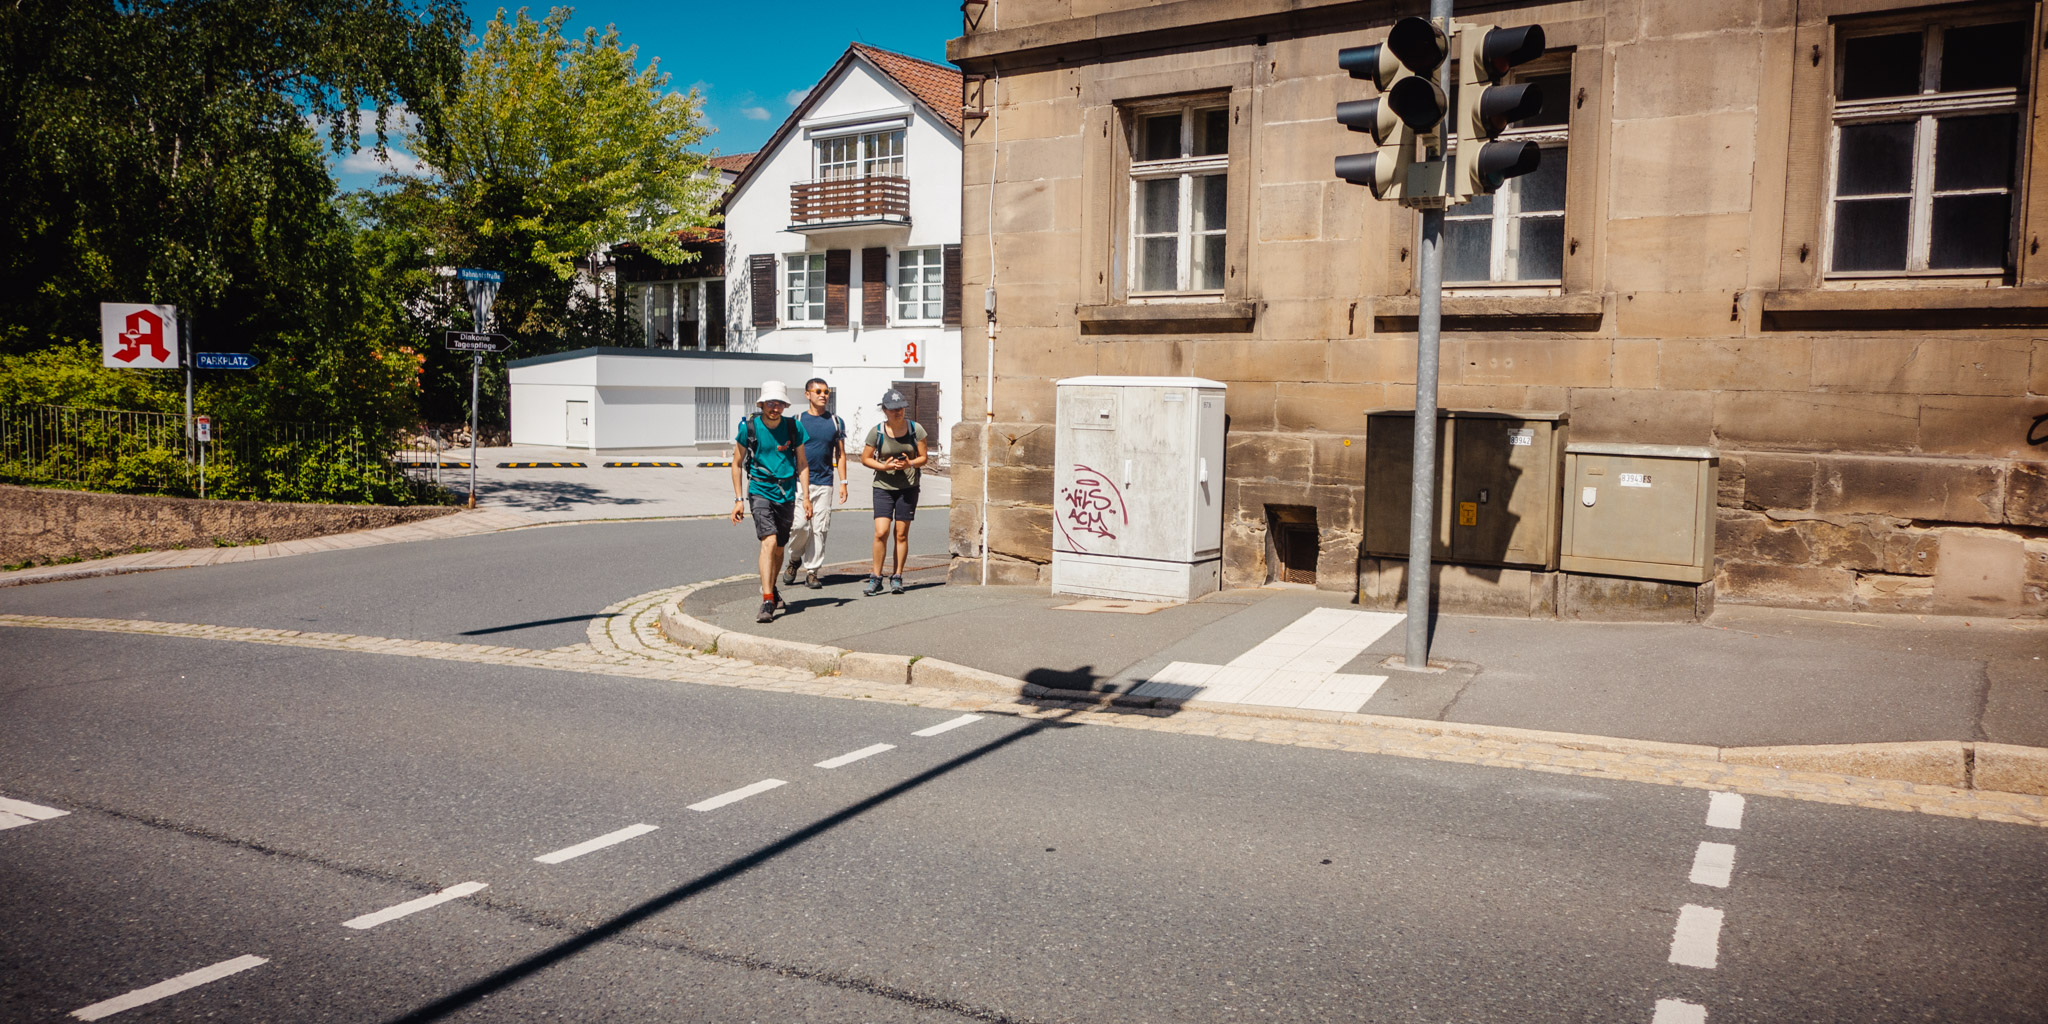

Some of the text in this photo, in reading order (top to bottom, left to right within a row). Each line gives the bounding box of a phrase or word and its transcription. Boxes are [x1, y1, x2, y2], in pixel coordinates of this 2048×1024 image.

[112, 309, 171, 363] A
[460, 333, 491, 342] Diakonie
[454, 340, 497, 351] Tagespflege
[903, 341, 919, 364] A
[200, 356, 249, 366] PARKPLATZ
